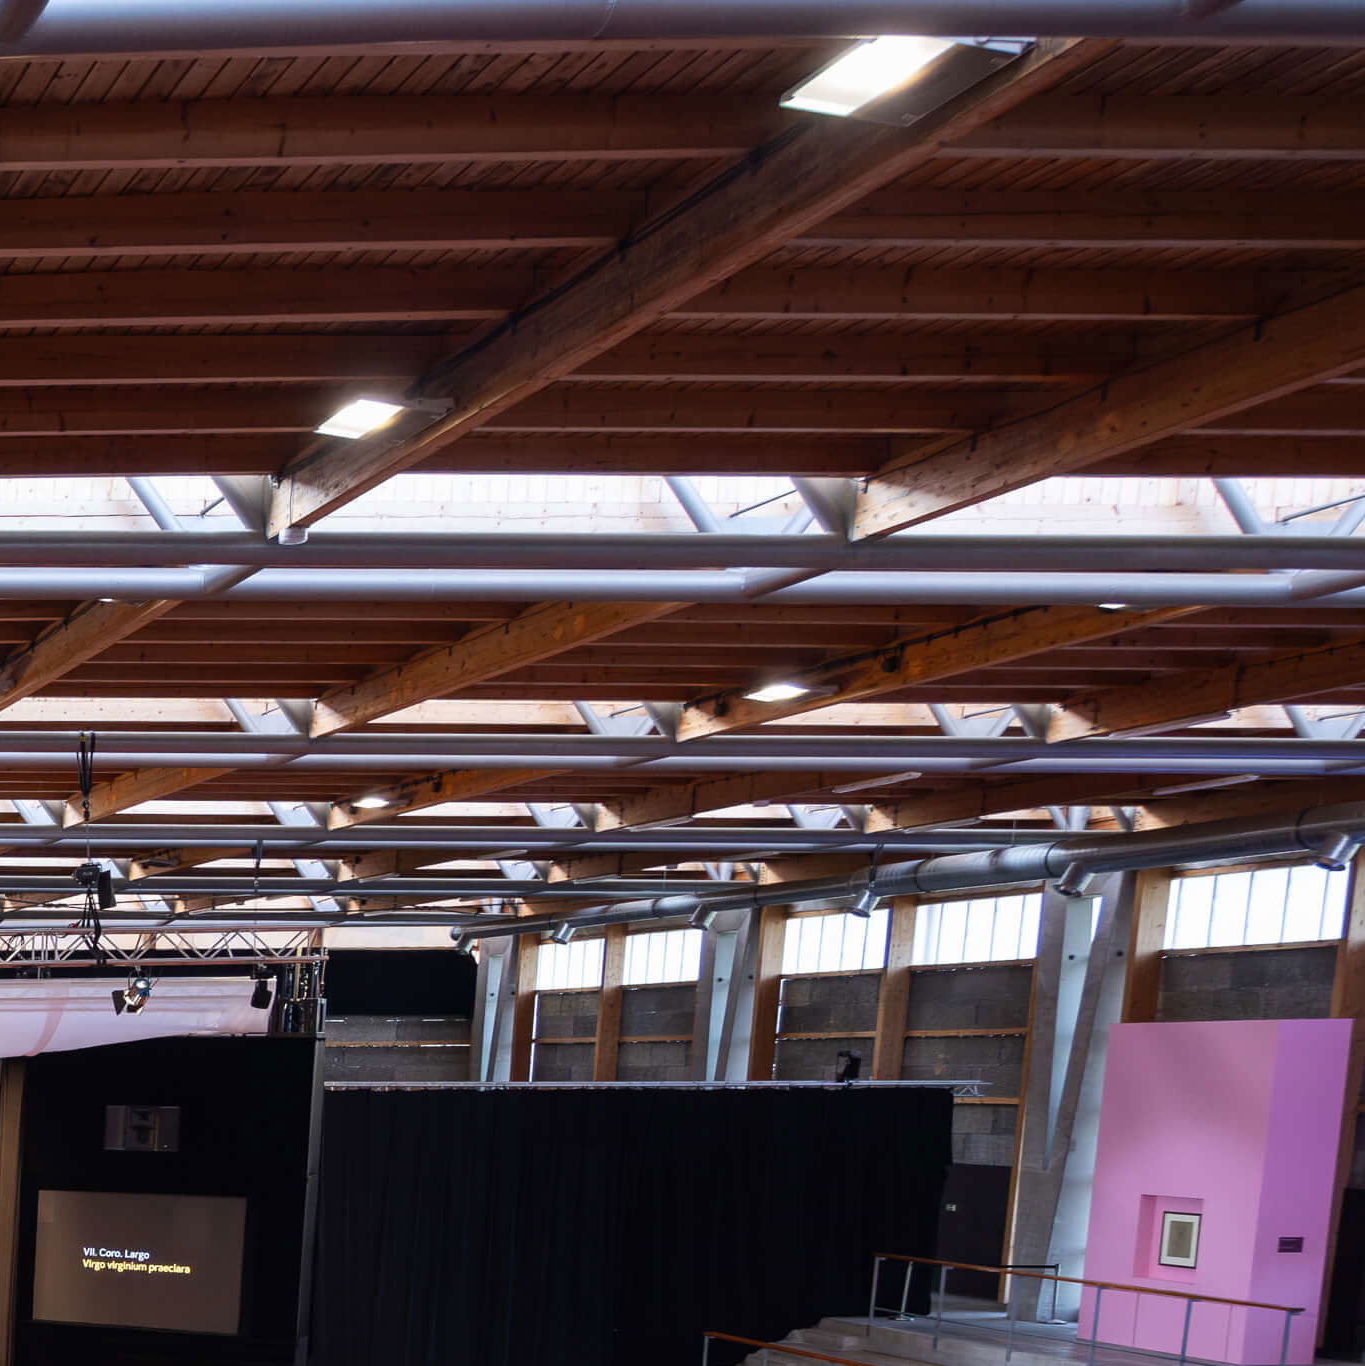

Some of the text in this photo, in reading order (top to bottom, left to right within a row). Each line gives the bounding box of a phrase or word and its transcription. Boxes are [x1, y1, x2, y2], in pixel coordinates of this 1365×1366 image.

[83, 1247, 150, 1261] VII. Coro. Largo
[82, 1259, 191, 1274] Virgo virginium praeclara
